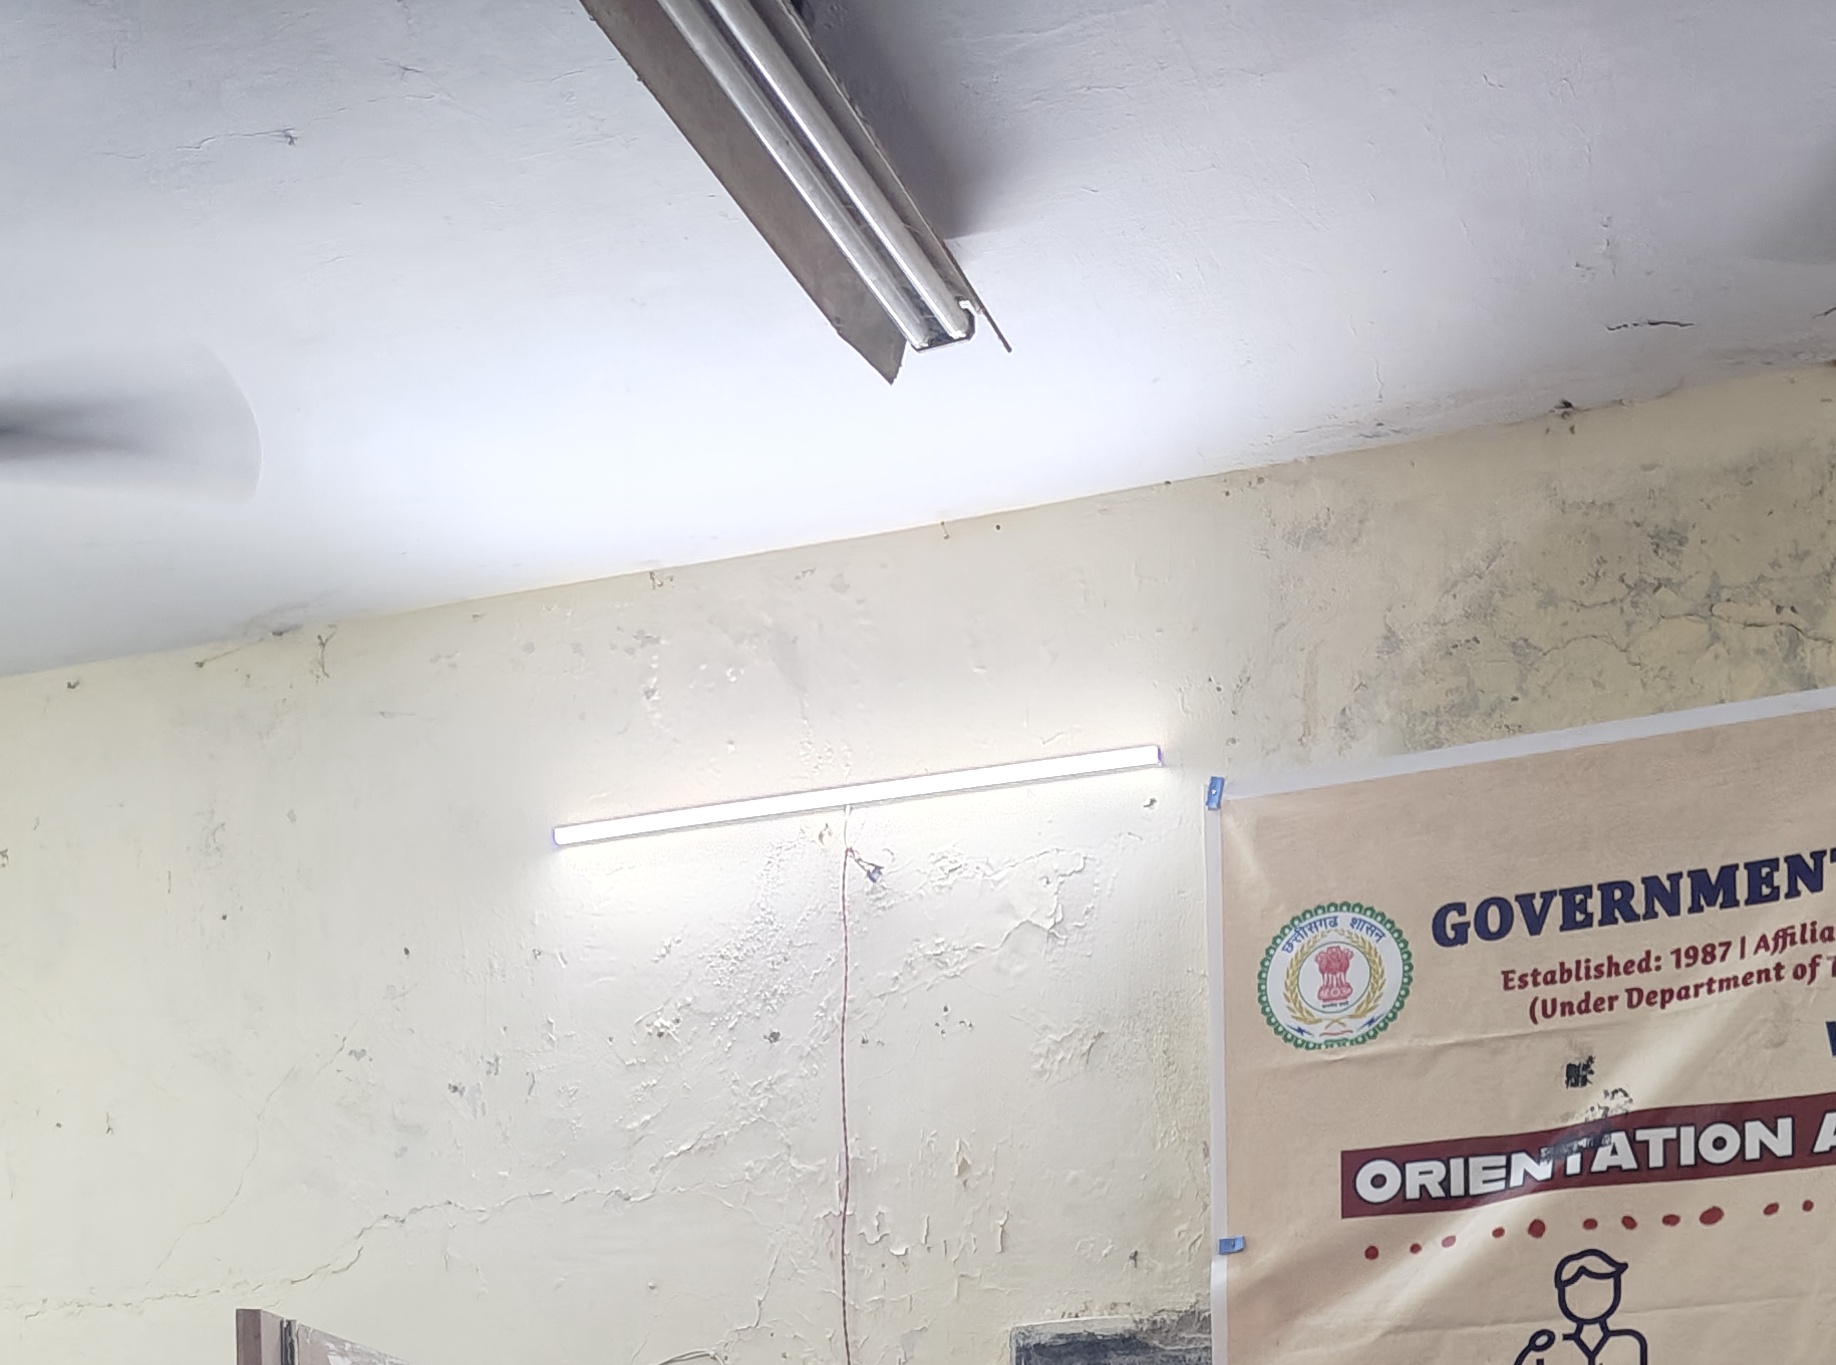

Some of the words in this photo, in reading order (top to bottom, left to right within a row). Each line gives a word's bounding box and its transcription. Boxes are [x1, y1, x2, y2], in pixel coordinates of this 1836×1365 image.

[1349, 916, 1387, 944] शासन
[1432, 848, 1836, 949] GOVERNMEN
[1501, 949, 1662, 992] Established:
[1669, 940, 1732, 971] 1987
[1529, 990, 1620, 1025] (Under
[1626, 961, 1785, 1010] Department
[1792, 953, 1823, 985] of
[1354, 1116, 1795, 1205] ORIENTATION
